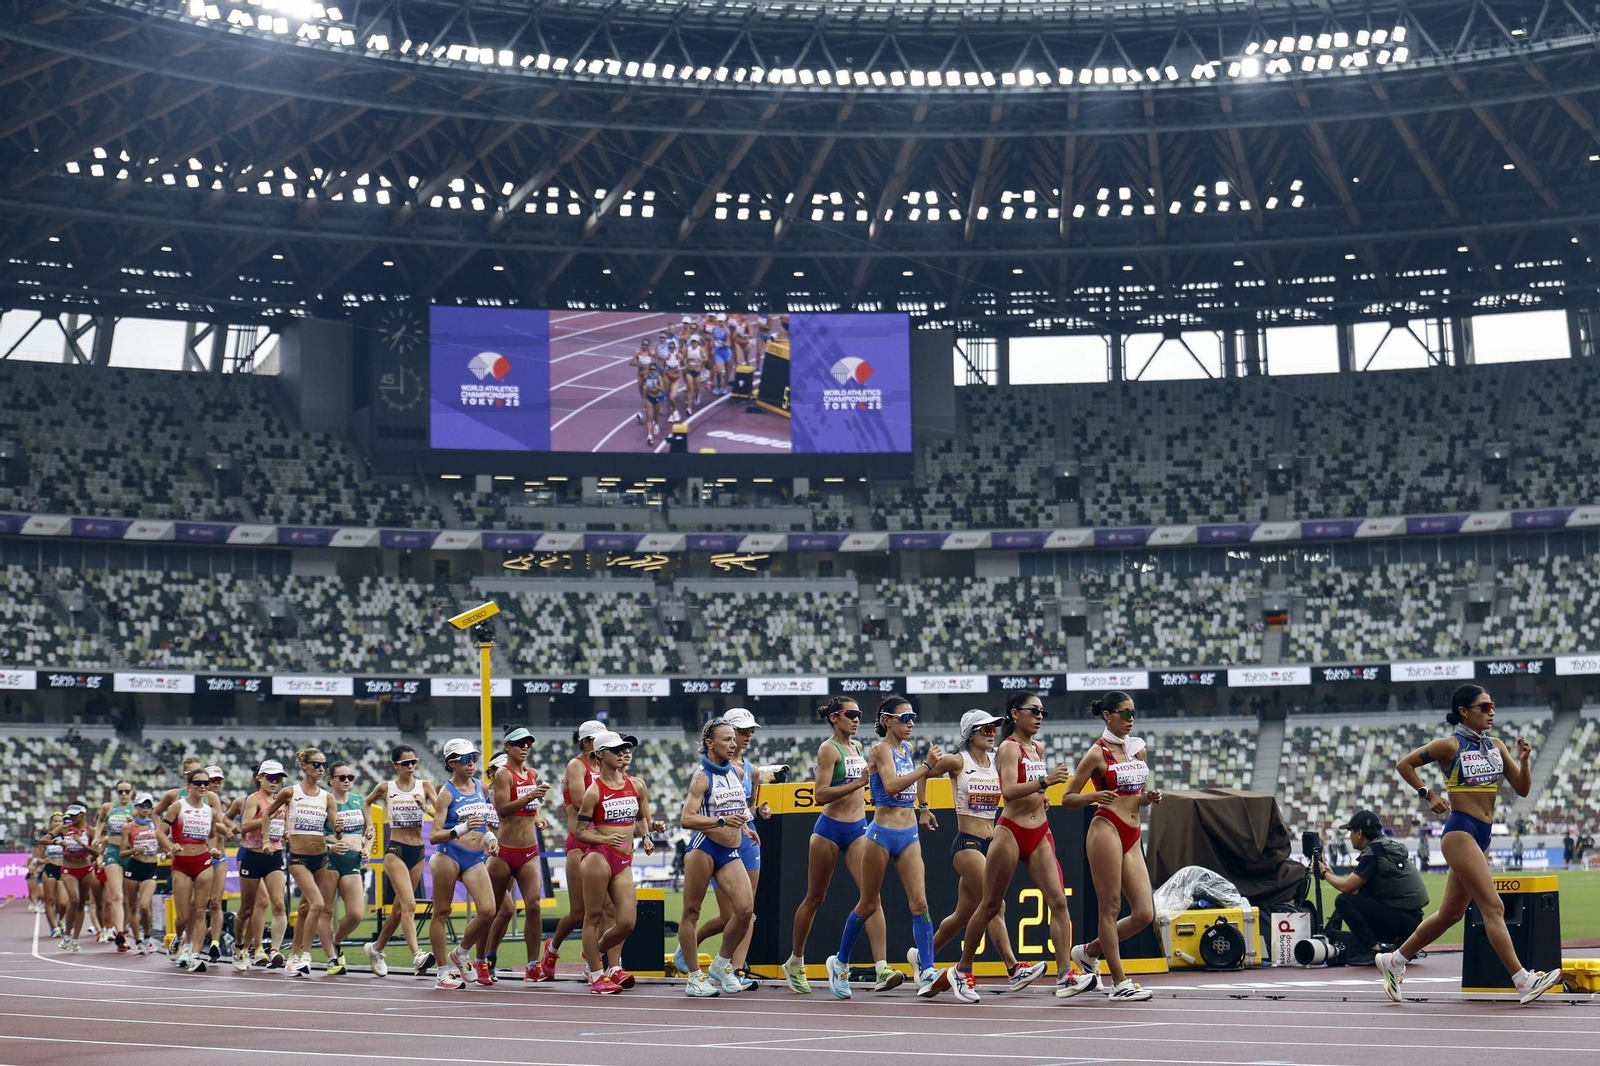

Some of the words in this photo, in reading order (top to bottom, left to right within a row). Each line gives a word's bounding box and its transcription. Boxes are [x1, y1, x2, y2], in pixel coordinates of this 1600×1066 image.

[380, 374, 395, 385] 45
[460, 384, 484, 392] WORLD
[485, 385, 519, 393] ATHLETICS
[460, 391, 519, 400] CHAMPIONSHIPS
[462, 610, 486, 626] SEIKO
[1405, 666, 1431, 678] TOKYO
[1445, 665, 1459, 677] 25
[1487, 662, 1514, 675] TOKYO
[1527, 660, 1543, 674] 25
[7, 674, 22, 686] 25
[1161, 673, 1187, 686] TOKYO
[1200, 672, 1216, 685] 25
[1242, 672, 1268, 683] TOKYO
[1279, 671, 1296, 682] 25
[1323, 669, 1350, 681] TOKYO
[1362, 667, 1378, 680] 25
[49, 674, 75, 687] TOKYO
[86, 675, 102, 688] 25
[128, 677, 154, 689] TOKYO
[166, 677, 182, 690] 25
[207, 678, 234, 691] TOKYO
[245, 679, 261, 692] 25
[287, 680, 312, 692] TOKYO
[325, 681, 339, 692] 25
[365, 680, 392, 693] TOKYO
[403, 681, 419, 693] 25
[445, 681, 470, 693] TOKYO
[603, 682, 628, 693] TOKYO
[641, 681, 656, 693] 25
[761, 681, 787, 692] TOKYO
[801, 681, 814, 692] 25
[840, 679, 866, 691] TOKYO
[879, 679, 895, 692] 25
[920, 679, 946, 690] TOKYO
[959, 679, 974, 690] 25
[1000, 677, 1026, 689] TOKYO
[1039, 677, 1055, 689] 25
[1080, 676, 1106, 687] TOKYO
[1120, 676, 1134, 687] 25
[523, 681, 550, 693] TOKYO
[561, 681, 577, 694] 25
[682, 681, 709, 694] TOKYO
[720, 681, 736, 694] 25
[1462, 752, 1499, 761] HONA
[1464, 763, 1495, 775] TORRES
[604, 798, 636, 808] HONDA
[969, 792, 995, 803] PÉREZ
[297, 809, 326, 817] HONDA
[606, 807, 632, 819] PENG
[1494, 880, 1521, 891] IKO
